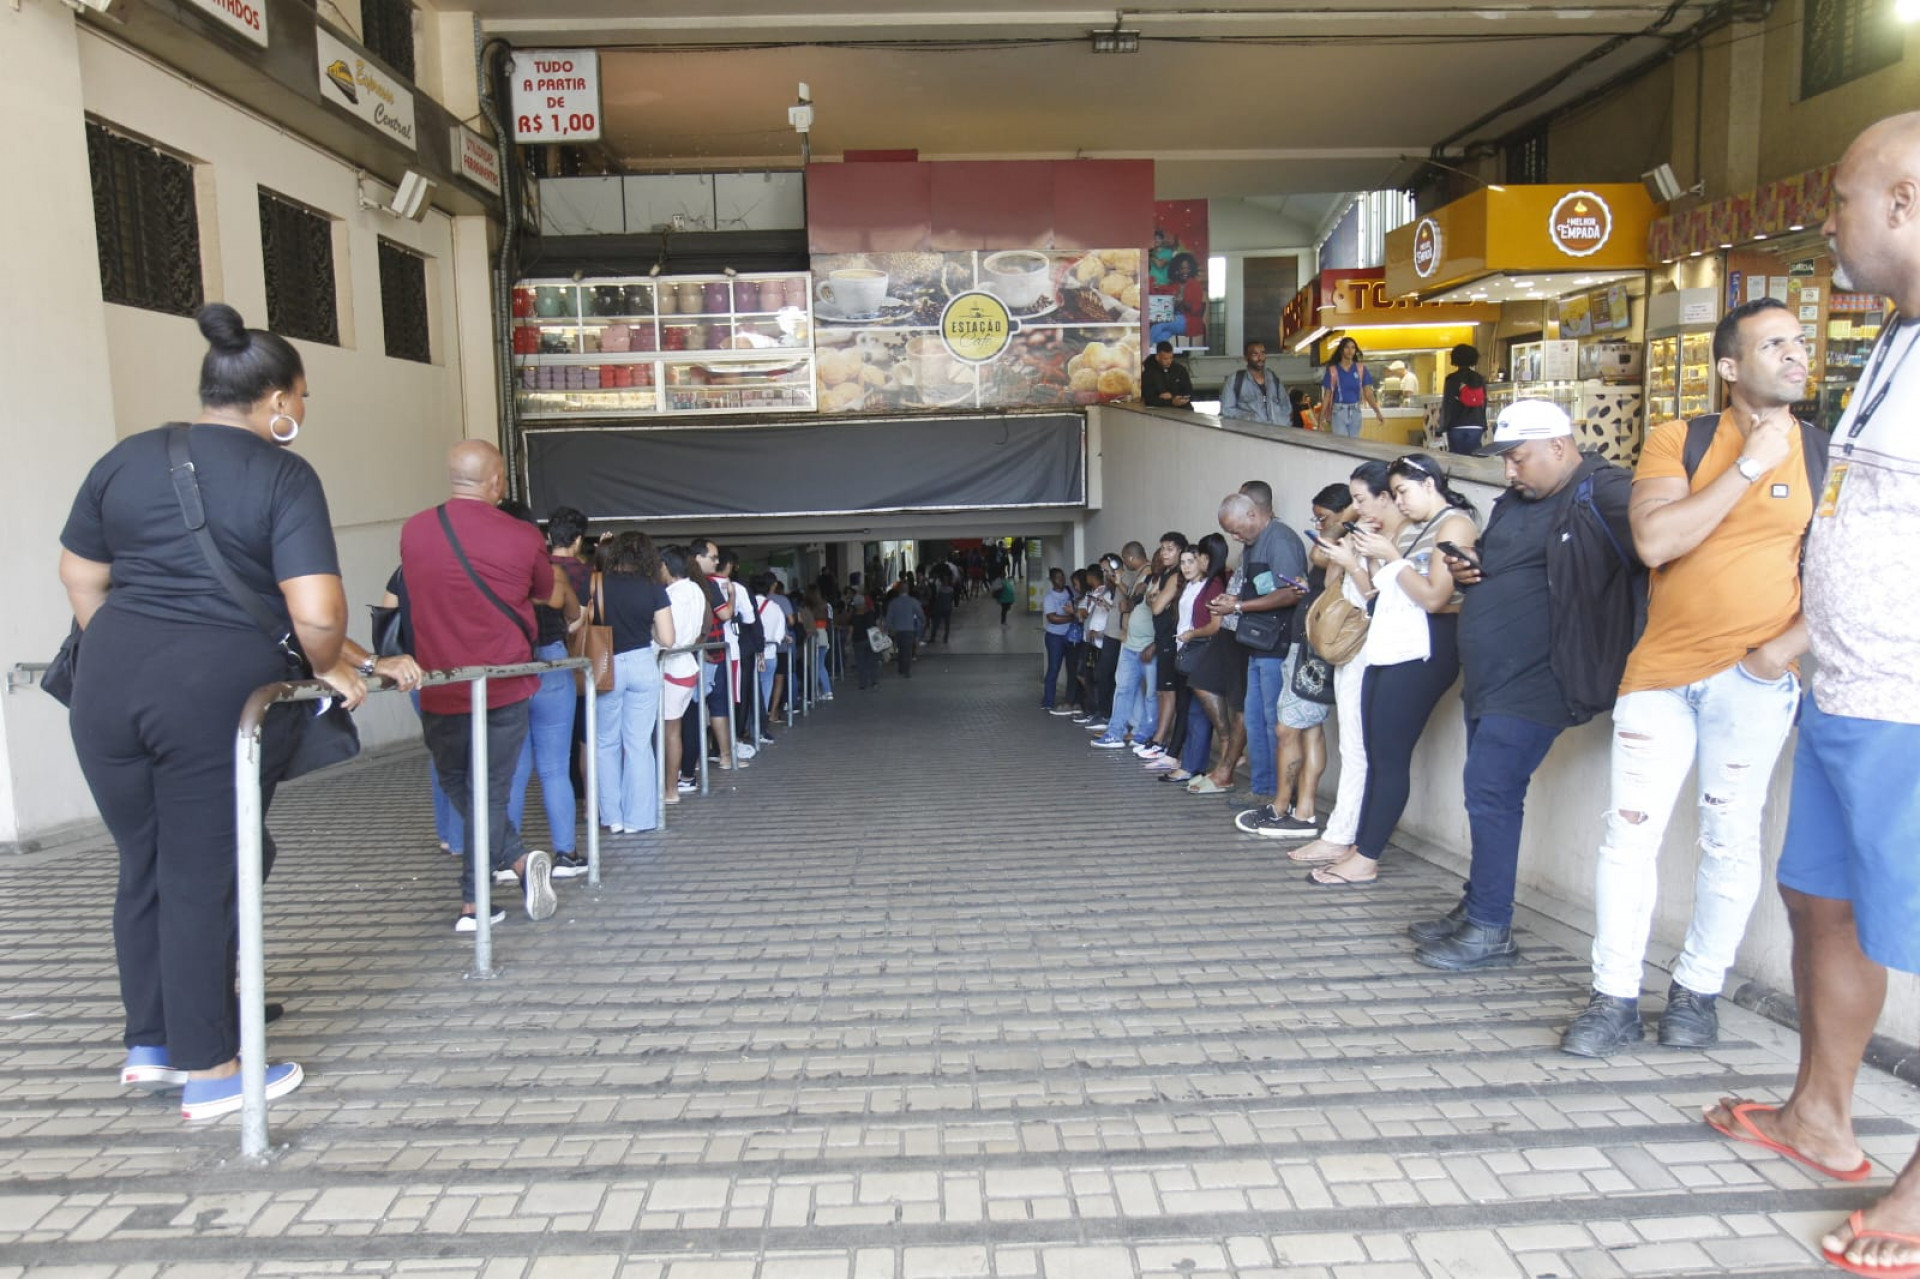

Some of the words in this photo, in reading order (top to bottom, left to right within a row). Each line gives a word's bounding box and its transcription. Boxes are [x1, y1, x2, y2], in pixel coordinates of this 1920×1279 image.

[533, 60, 574, 74] TUDO
[523, 78, 534, 92] A
[537, 77, 586, 91] PARTIR
[546, 96, 565, 109] DE
[374, 102, 411, 140] Central
[518, 113, 543, 133] R$
[551, 113, 595, 135] 1,00
[1570, 217, 1597, 226] MELHOR
[1557, 223, 1601, 240] EMPADA
